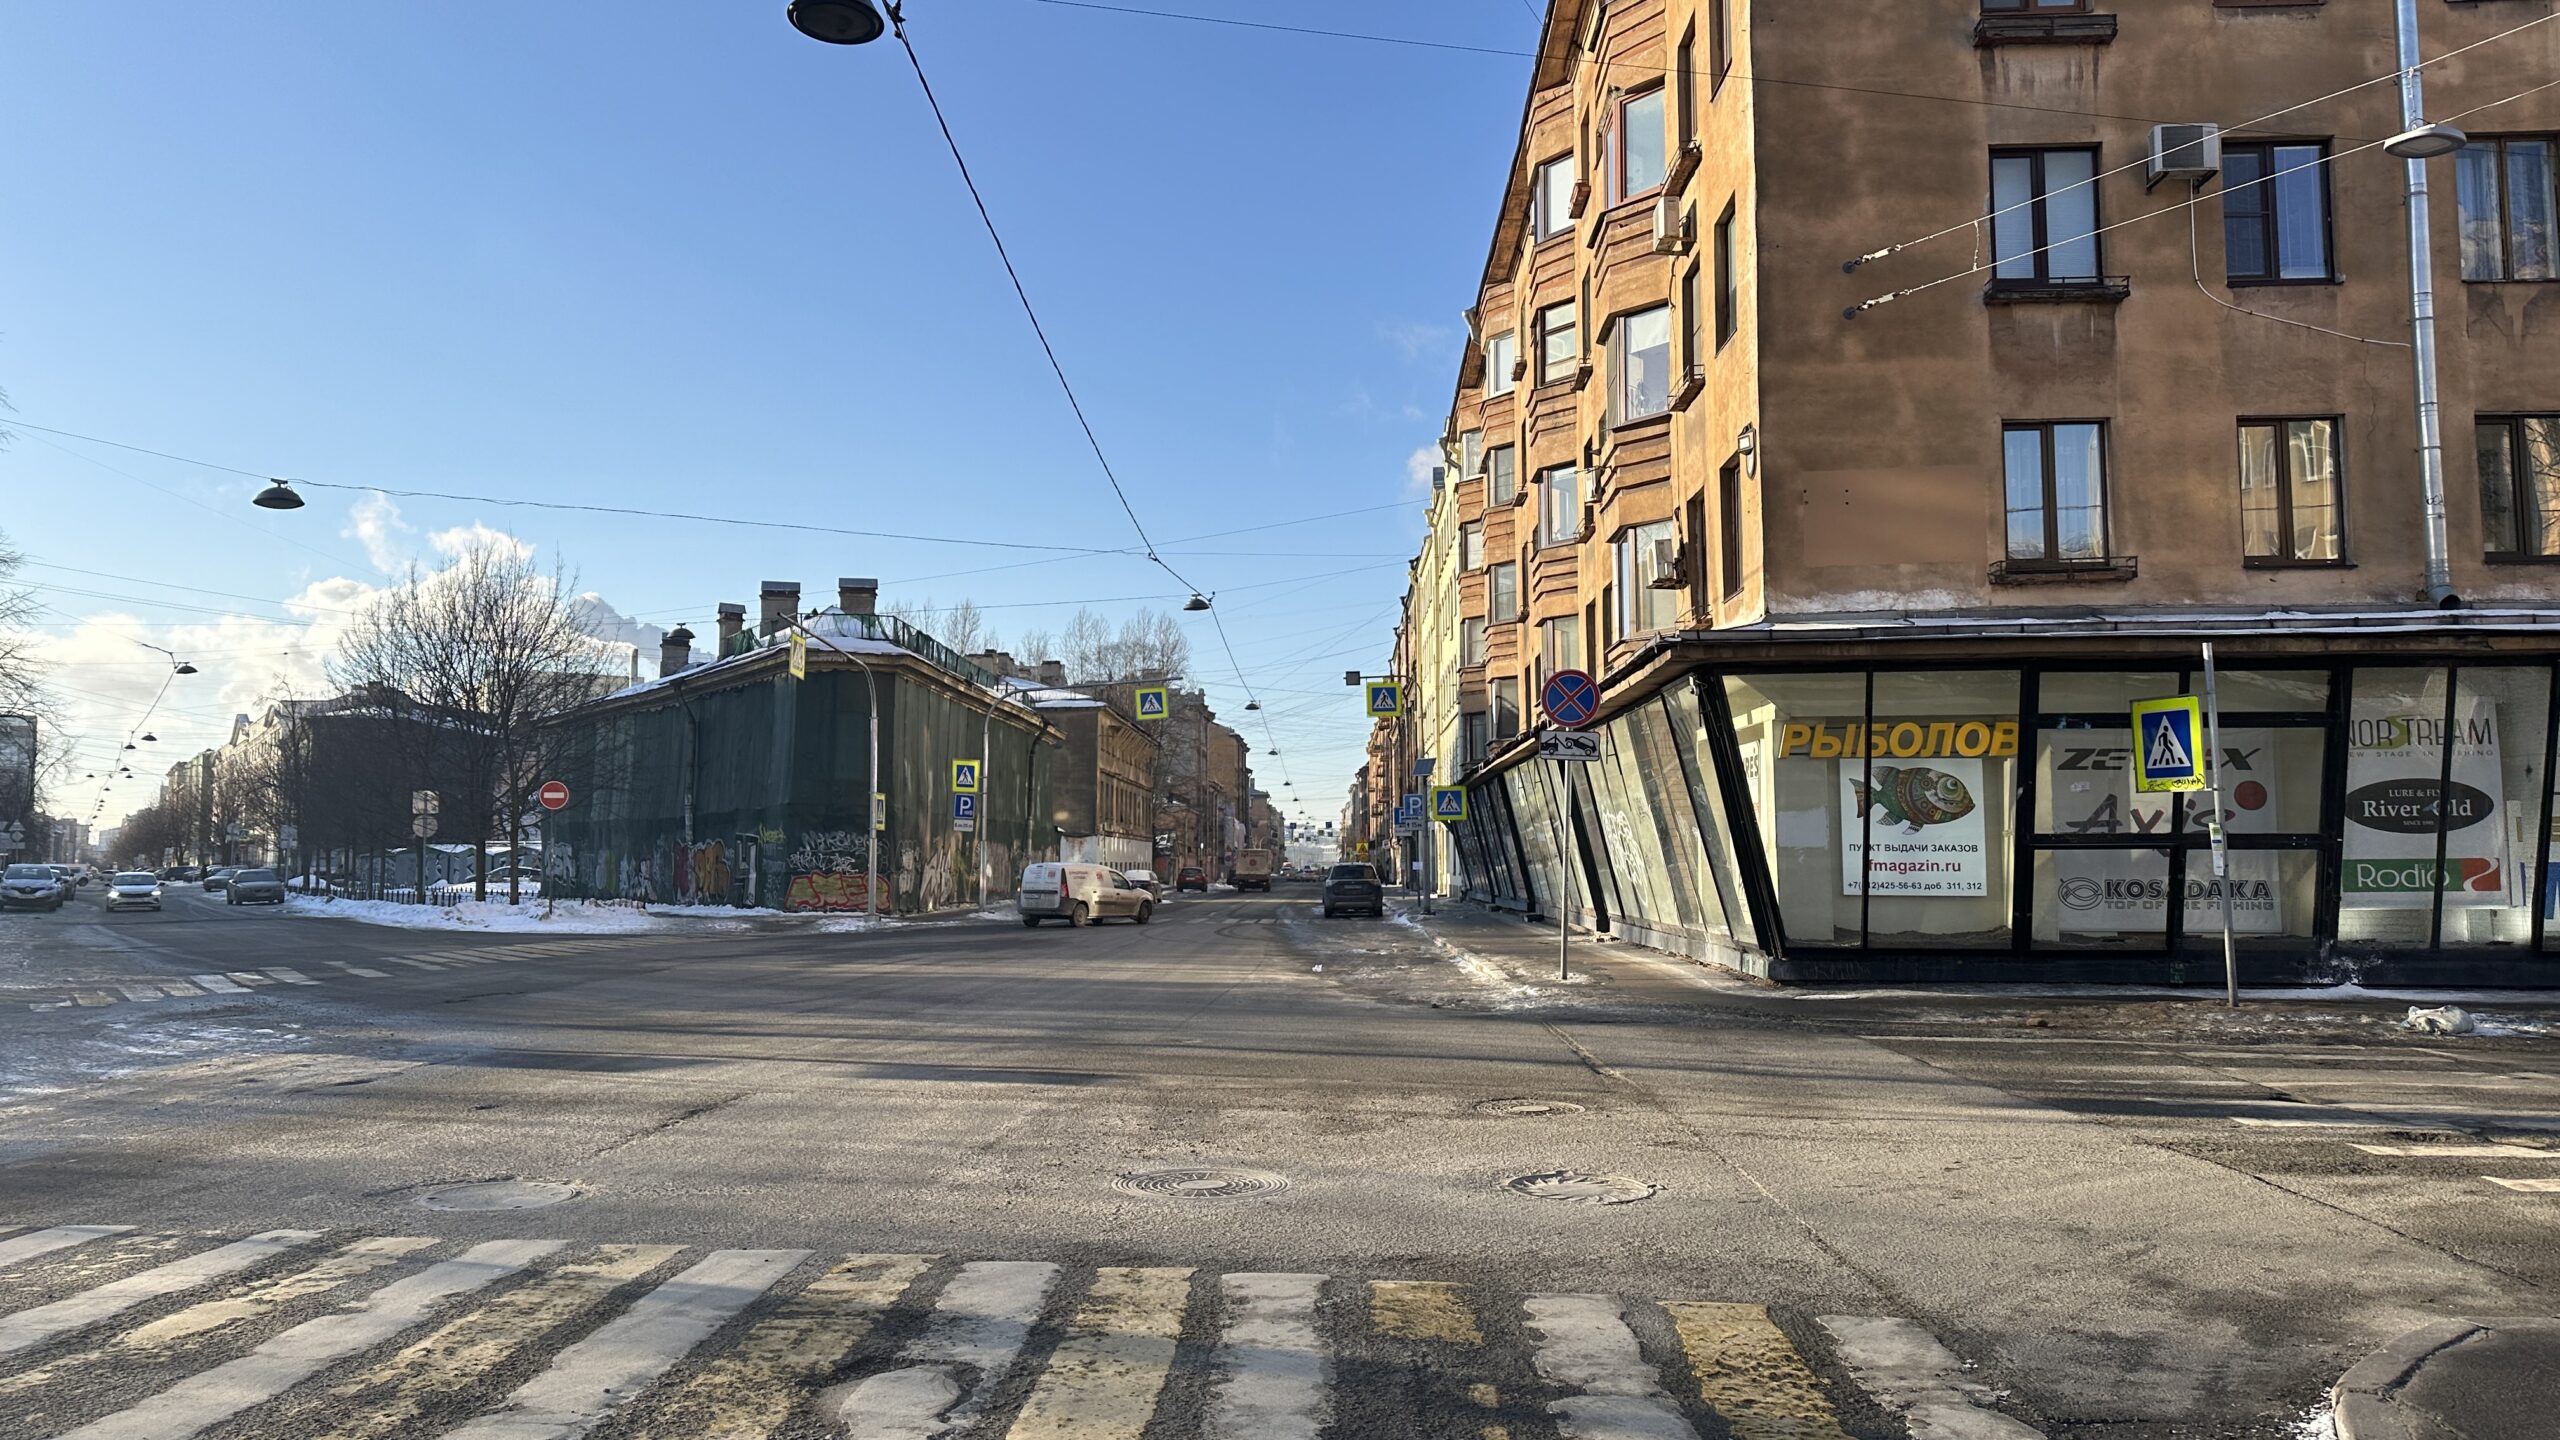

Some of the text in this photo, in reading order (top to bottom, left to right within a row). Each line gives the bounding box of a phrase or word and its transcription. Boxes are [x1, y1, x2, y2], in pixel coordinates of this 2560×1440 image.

[1779, 721, 2019, 758] РЫБОЛОВ
[2389, 789, 2414, 797] LURE
[2416, 789, 2424, 797] &
[2362, 800, 2421, 817] River
[1849, 843, 1978, 853] ПУКТ ВЫДАЧИ ЗАКАЗОВ
[1868, 859, 1961, 875] fmagazin.ru
[2357, 863, 2450, 888] Rodio
[1847, 881, 1922, 891] +7(12)425-56-63
[1967, 882, 1983, 890] 312
[2104, 878, 2274, 901] KOSDAKA
[2106, 900, 2274, 911] TOP OF HE FIHING
